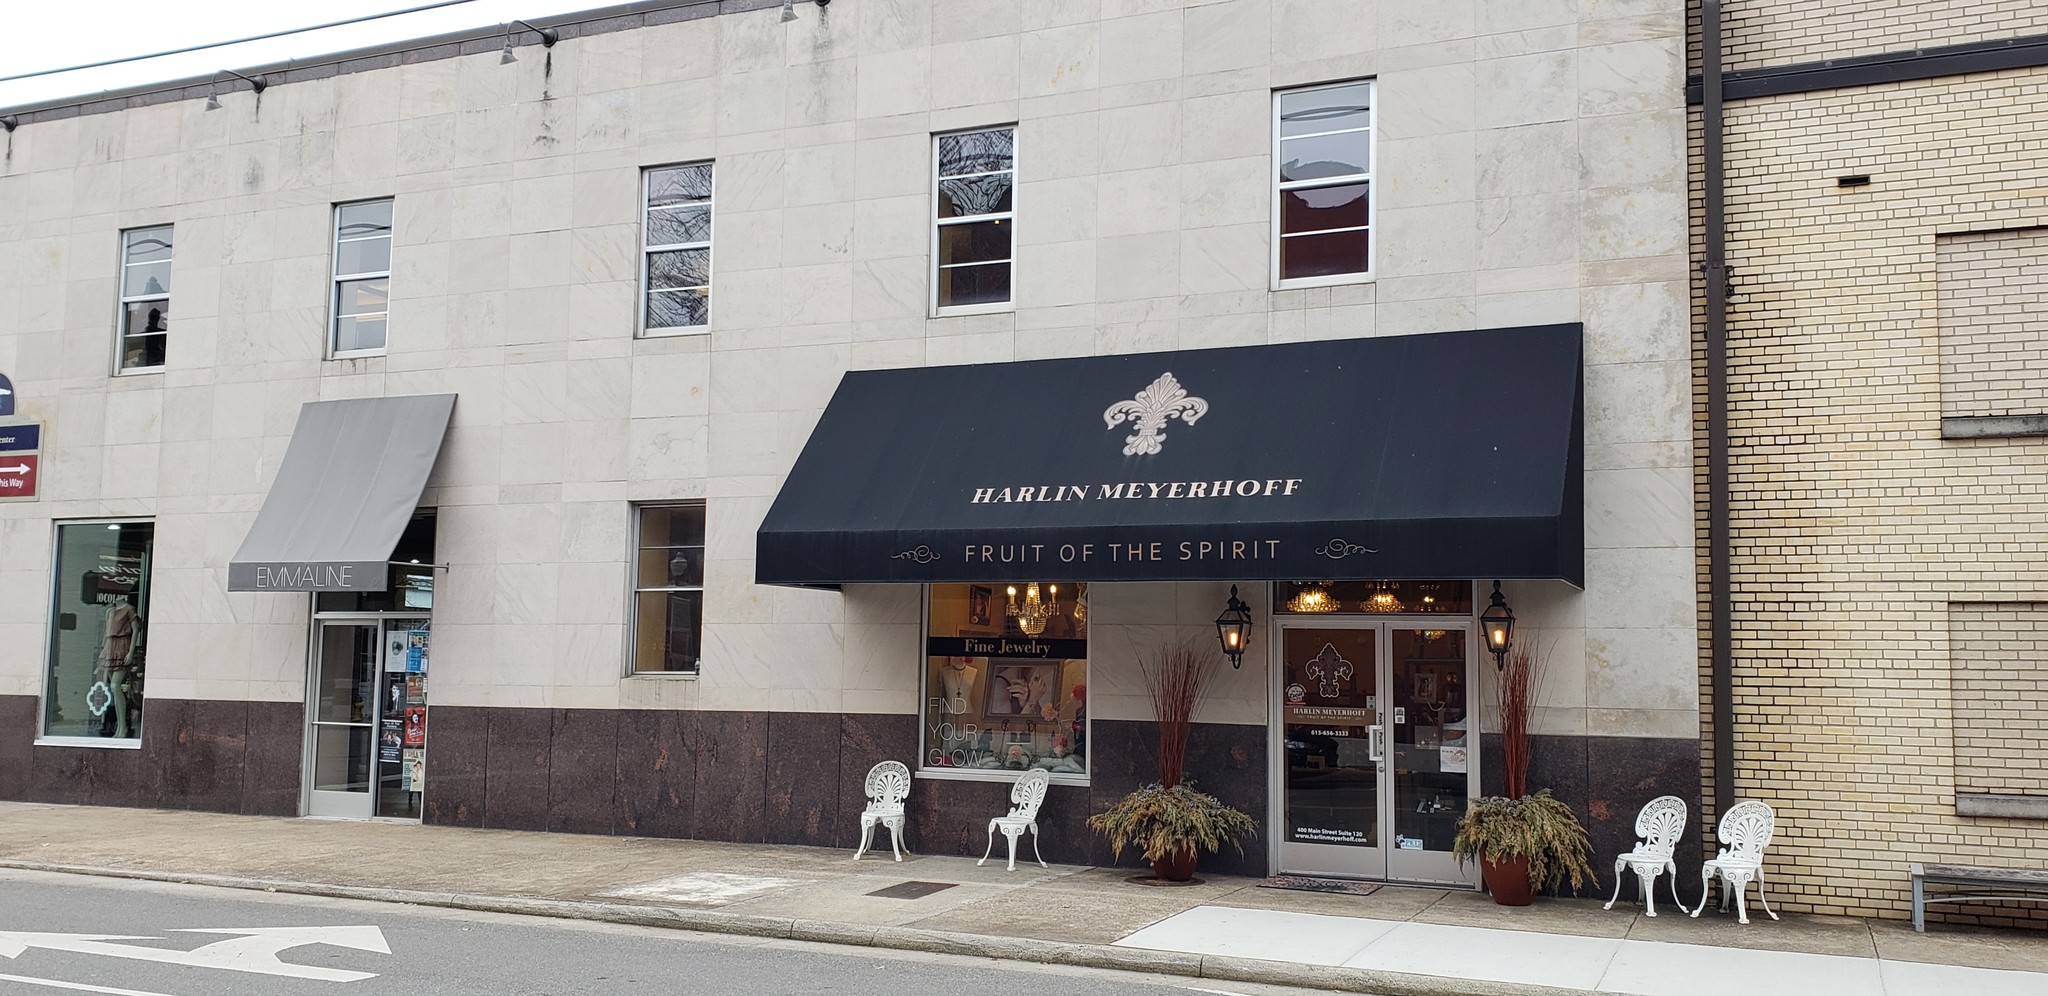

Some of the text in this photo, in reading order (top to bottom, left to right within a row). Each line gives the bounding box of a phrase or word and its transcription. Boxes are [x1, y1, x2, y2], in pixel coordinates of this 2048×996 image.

[9, 477, 24, 489] Way
[970, 478, 1303, 504] HARLIN MEYERHOFF
[964, 539, 1281, 563] FRUIT OF THE SPIRIT
[256, 565, 353, 588] EMMALINE
[963, 639, 1051, 657] Fine Jewelry
[928, 697, 967, 715] FIND
[928, 722, 978, 741] YOUR
[928, 748, 983, 767] GLOW
[1295, 833, 1367, 843] www.harlinmeyerhoff.com
